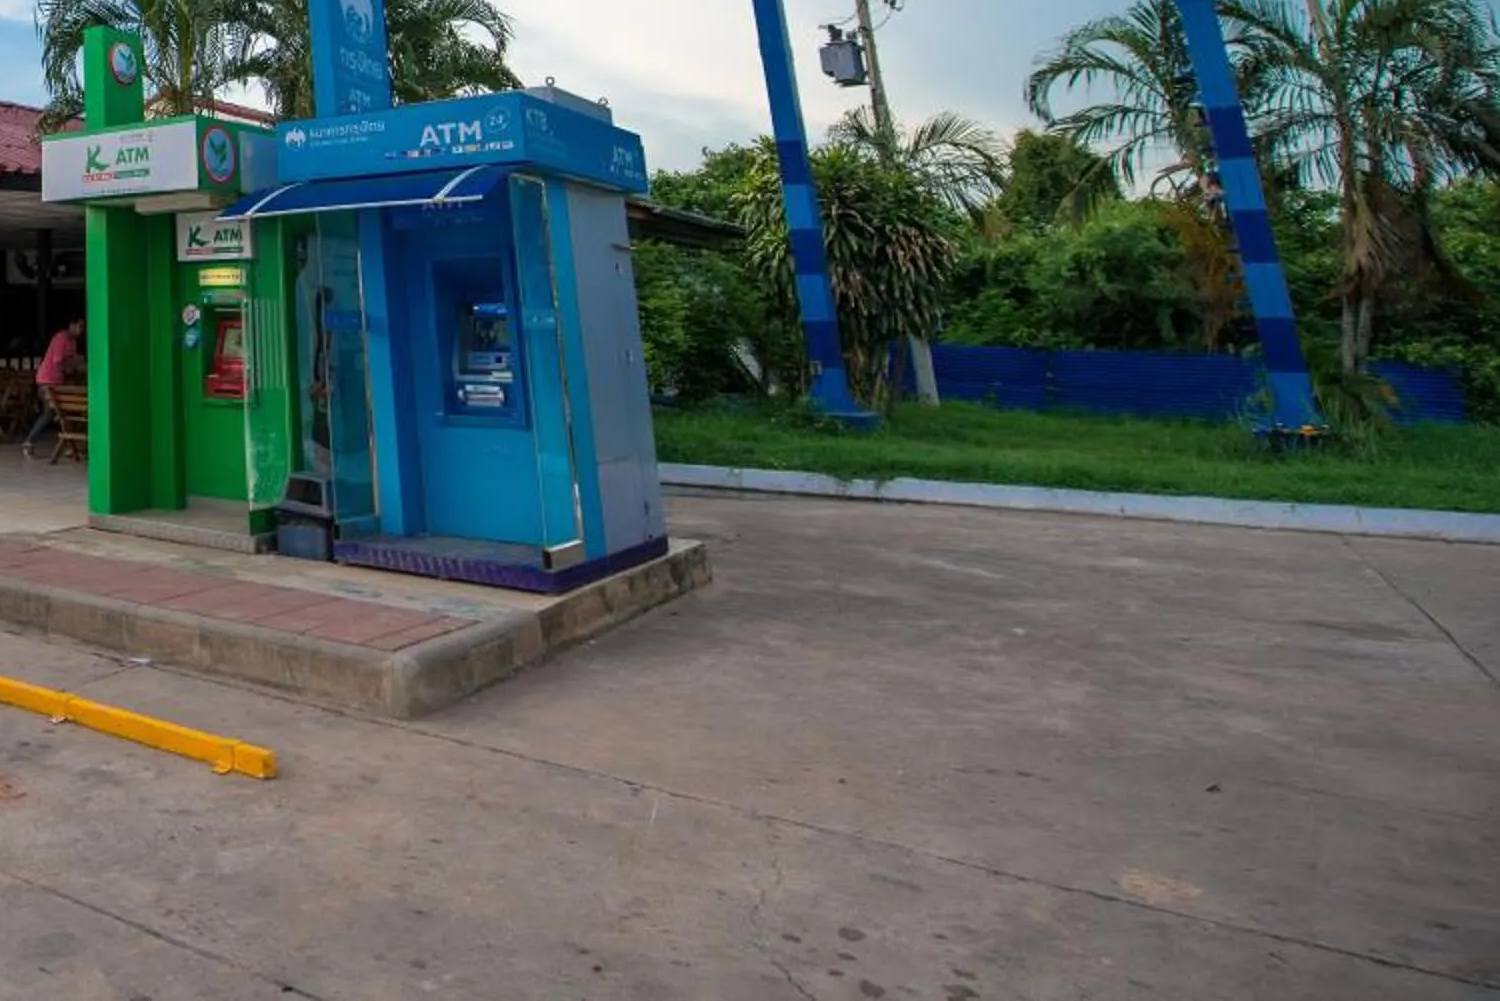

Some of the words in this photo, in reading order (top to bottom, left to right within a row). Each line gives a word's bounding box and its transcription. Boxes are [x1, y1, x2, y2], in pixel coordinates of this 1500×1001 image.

[420, 120, 482, 147] ATM
[86, 145, 110, 173] K
[115, 146, 150, 165] ATM
[188, 225, 212, 247] K
[213, 227, 243, 244] ATM
